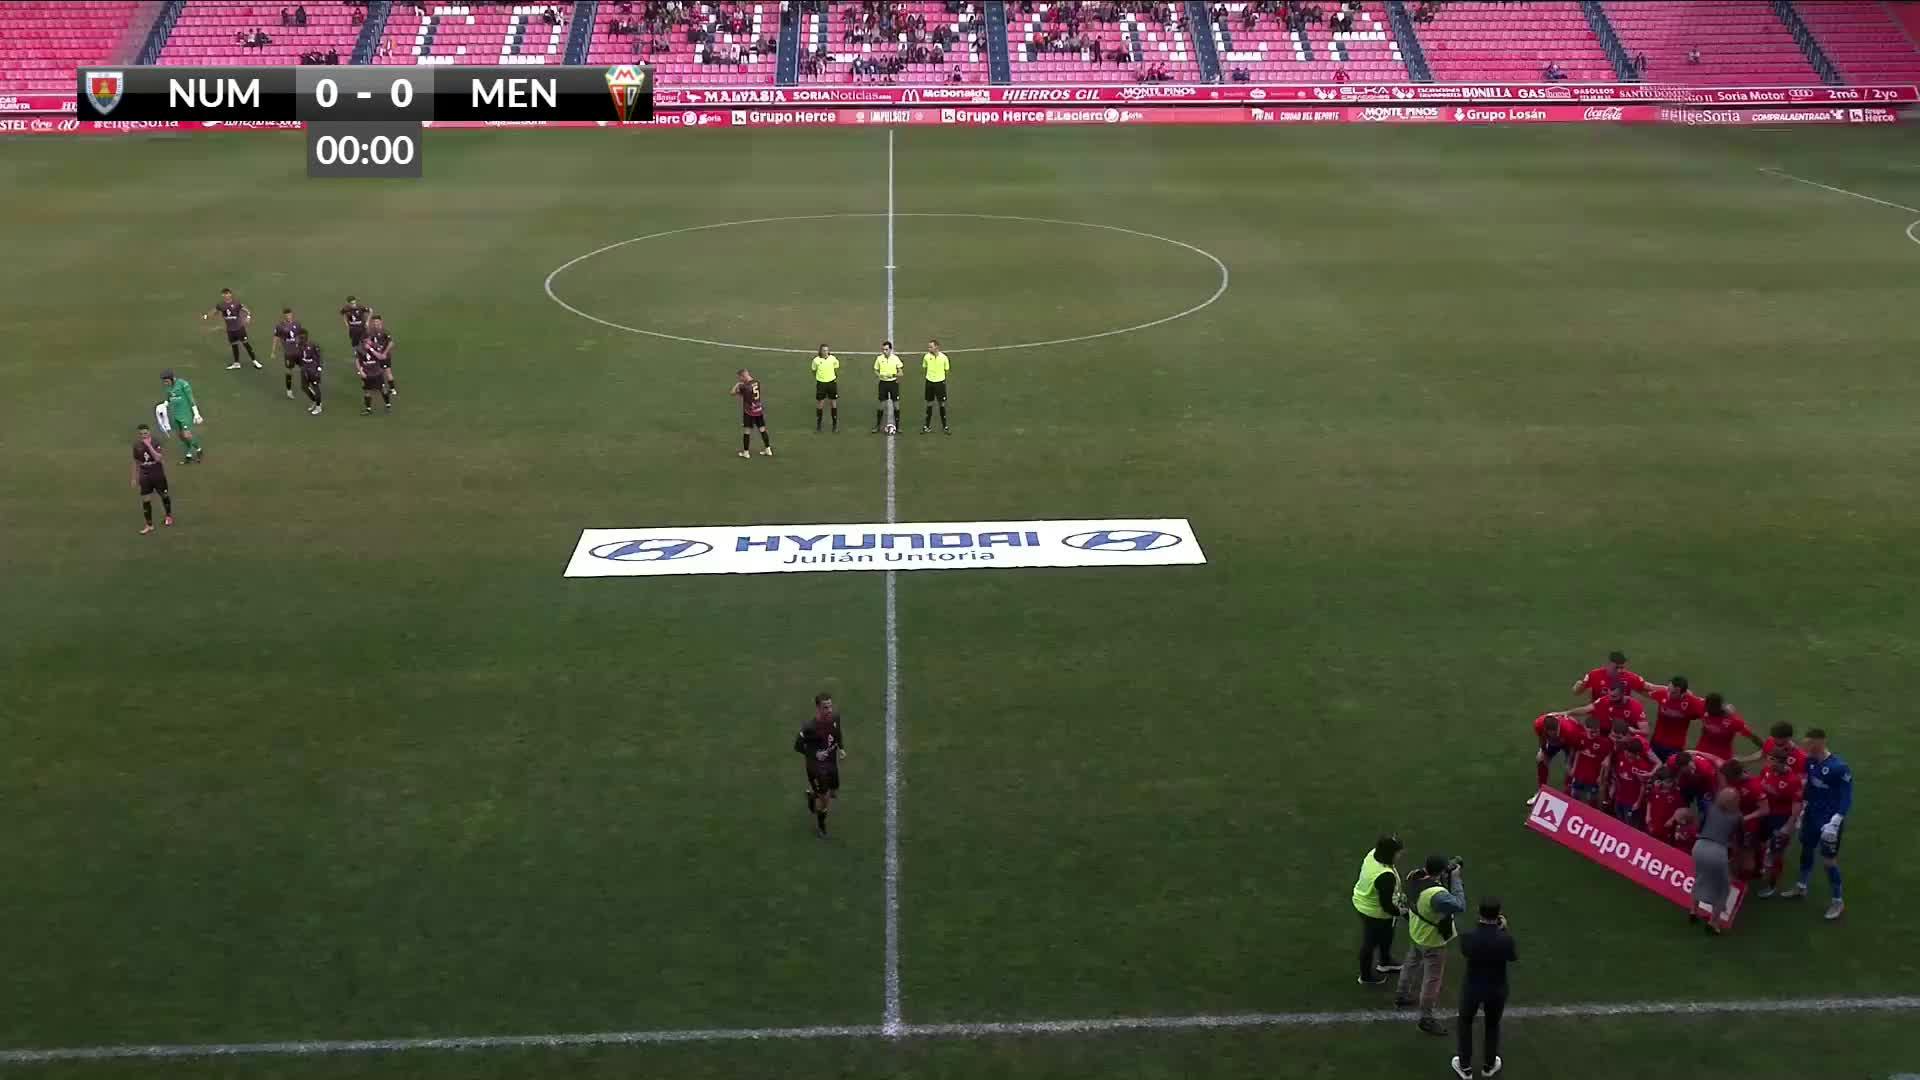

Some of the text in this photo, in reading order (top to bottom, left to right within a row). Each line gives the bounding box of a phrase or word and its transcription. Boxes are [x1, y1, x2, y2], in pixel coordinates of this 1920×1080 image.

[704, 91, 787, 102] MALVASIA
[923, 89, 990, 98] McDonald's
[1003, 90, 1070, 101] HIERROS
[1075, 90, 1100, 100] GIL
[1164, 88, 1196, 96] PINOS
[1462, 88, 1512, 98] BONILLA
[1518, 89, 1546, 98] GAS
[1718, 91, 1785, 101] Soria Motor
[750, 111, 836, 123] Grupo Herce
[956, 110, 1000, 124] Grupo
[1003, 110, 1045, 122] Herce
[1405, 108, 1439, 117] PINOS
[1467, 109, 1546, 122] Grupo Losán
[736, 531, 1040, 552] HYUNDAI
[783, 550, 996, 564] Julián Untoria
[1566, 815, 1696, 893] Grupo Herce
